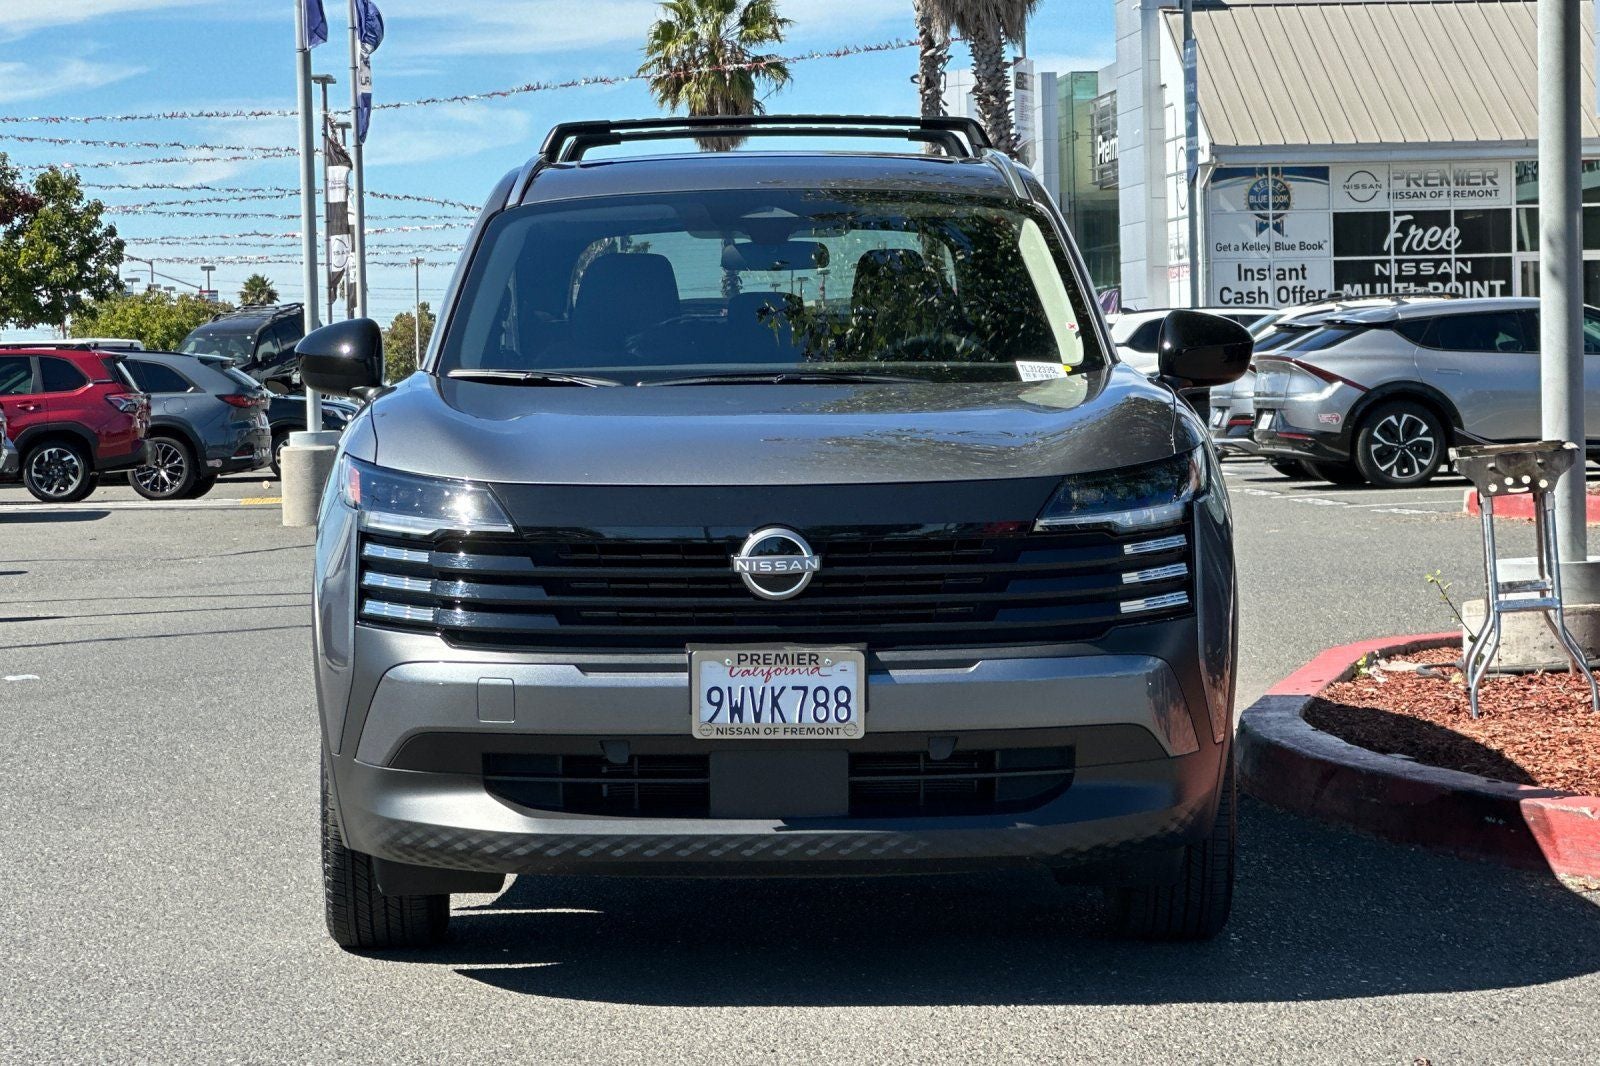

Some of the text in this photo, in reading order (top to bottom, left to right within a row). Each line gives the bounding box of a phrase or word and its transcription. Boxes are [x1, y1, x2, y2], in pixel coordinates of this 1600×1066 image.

[1387, 189, 1500, 200] NISSAN OF FREMONT
[1383, 214, 1462, 253] Free
[1215, 242, 1231, 252] Get
[1233, 244, 1240, 252] a
[1242, 242, 1271, 254] Kelley
[1274, 241, 1296, 251] Blue
[1237, 263, 1308, 281] Instant
[1374, 261, 1472, 276] NISSAN
[1219, 285, 1327, 305] Cash Offer
[736, 558, 819, 572] NISSAN
[737, 653, 819, 666] PREMIER
[728, 666, 832, 684] California
[706, 685, 852, 724] 9WVK788
[716, 726, 760, 736] NISSAN
[763, 726, 780, 736] OF
[783, 726, 842, 736] FREMONT
